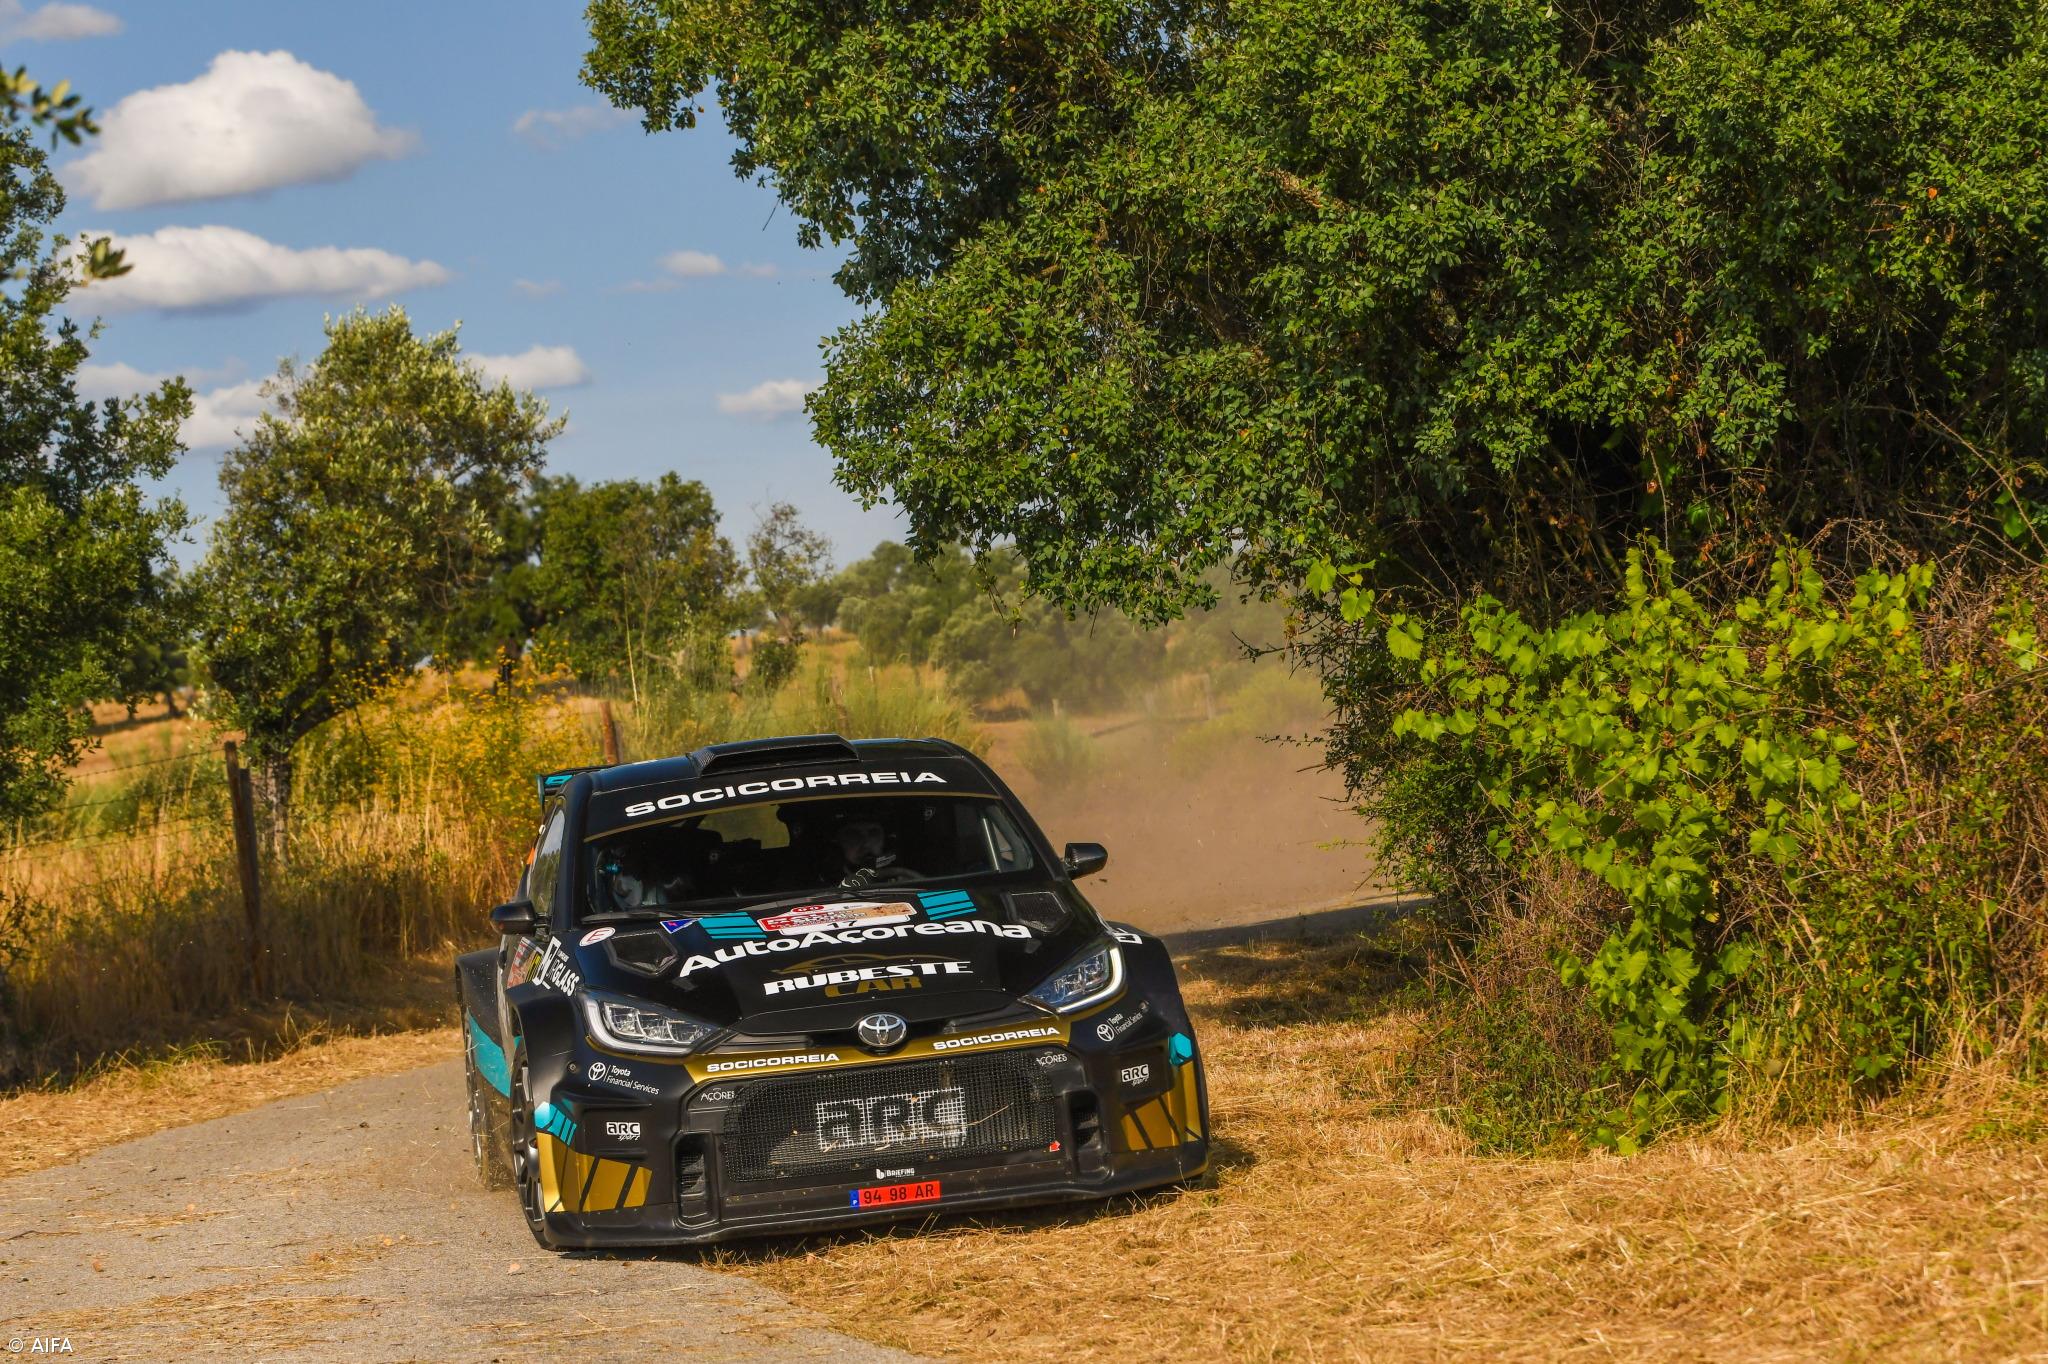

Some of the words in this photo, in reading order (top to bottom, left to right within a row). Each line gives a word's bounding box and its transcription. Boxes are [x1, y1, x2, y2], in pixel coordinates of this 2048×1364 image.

[624, 771, 947, 818] SOCICORREIA
[679, 919, 1032, 977] AutoAçoreana
[764, 960, 974, 996] RUBESTE
[824, 975, 924, 999] CAR
[932, 1026, 1061, 1051] SOCICORREIA
[611, 1065, 631, 1077] Toyota
[706, 1052, 840, 1073] SOCICORREIA
[606, 1075, 633, 1089] Financial
[632, 1081, 660, 1095] Services
[863, 1190, 882, 1204] 94
[890, 1186, 907, 1201] 98
[915, 1184, 934, 1199] AR
